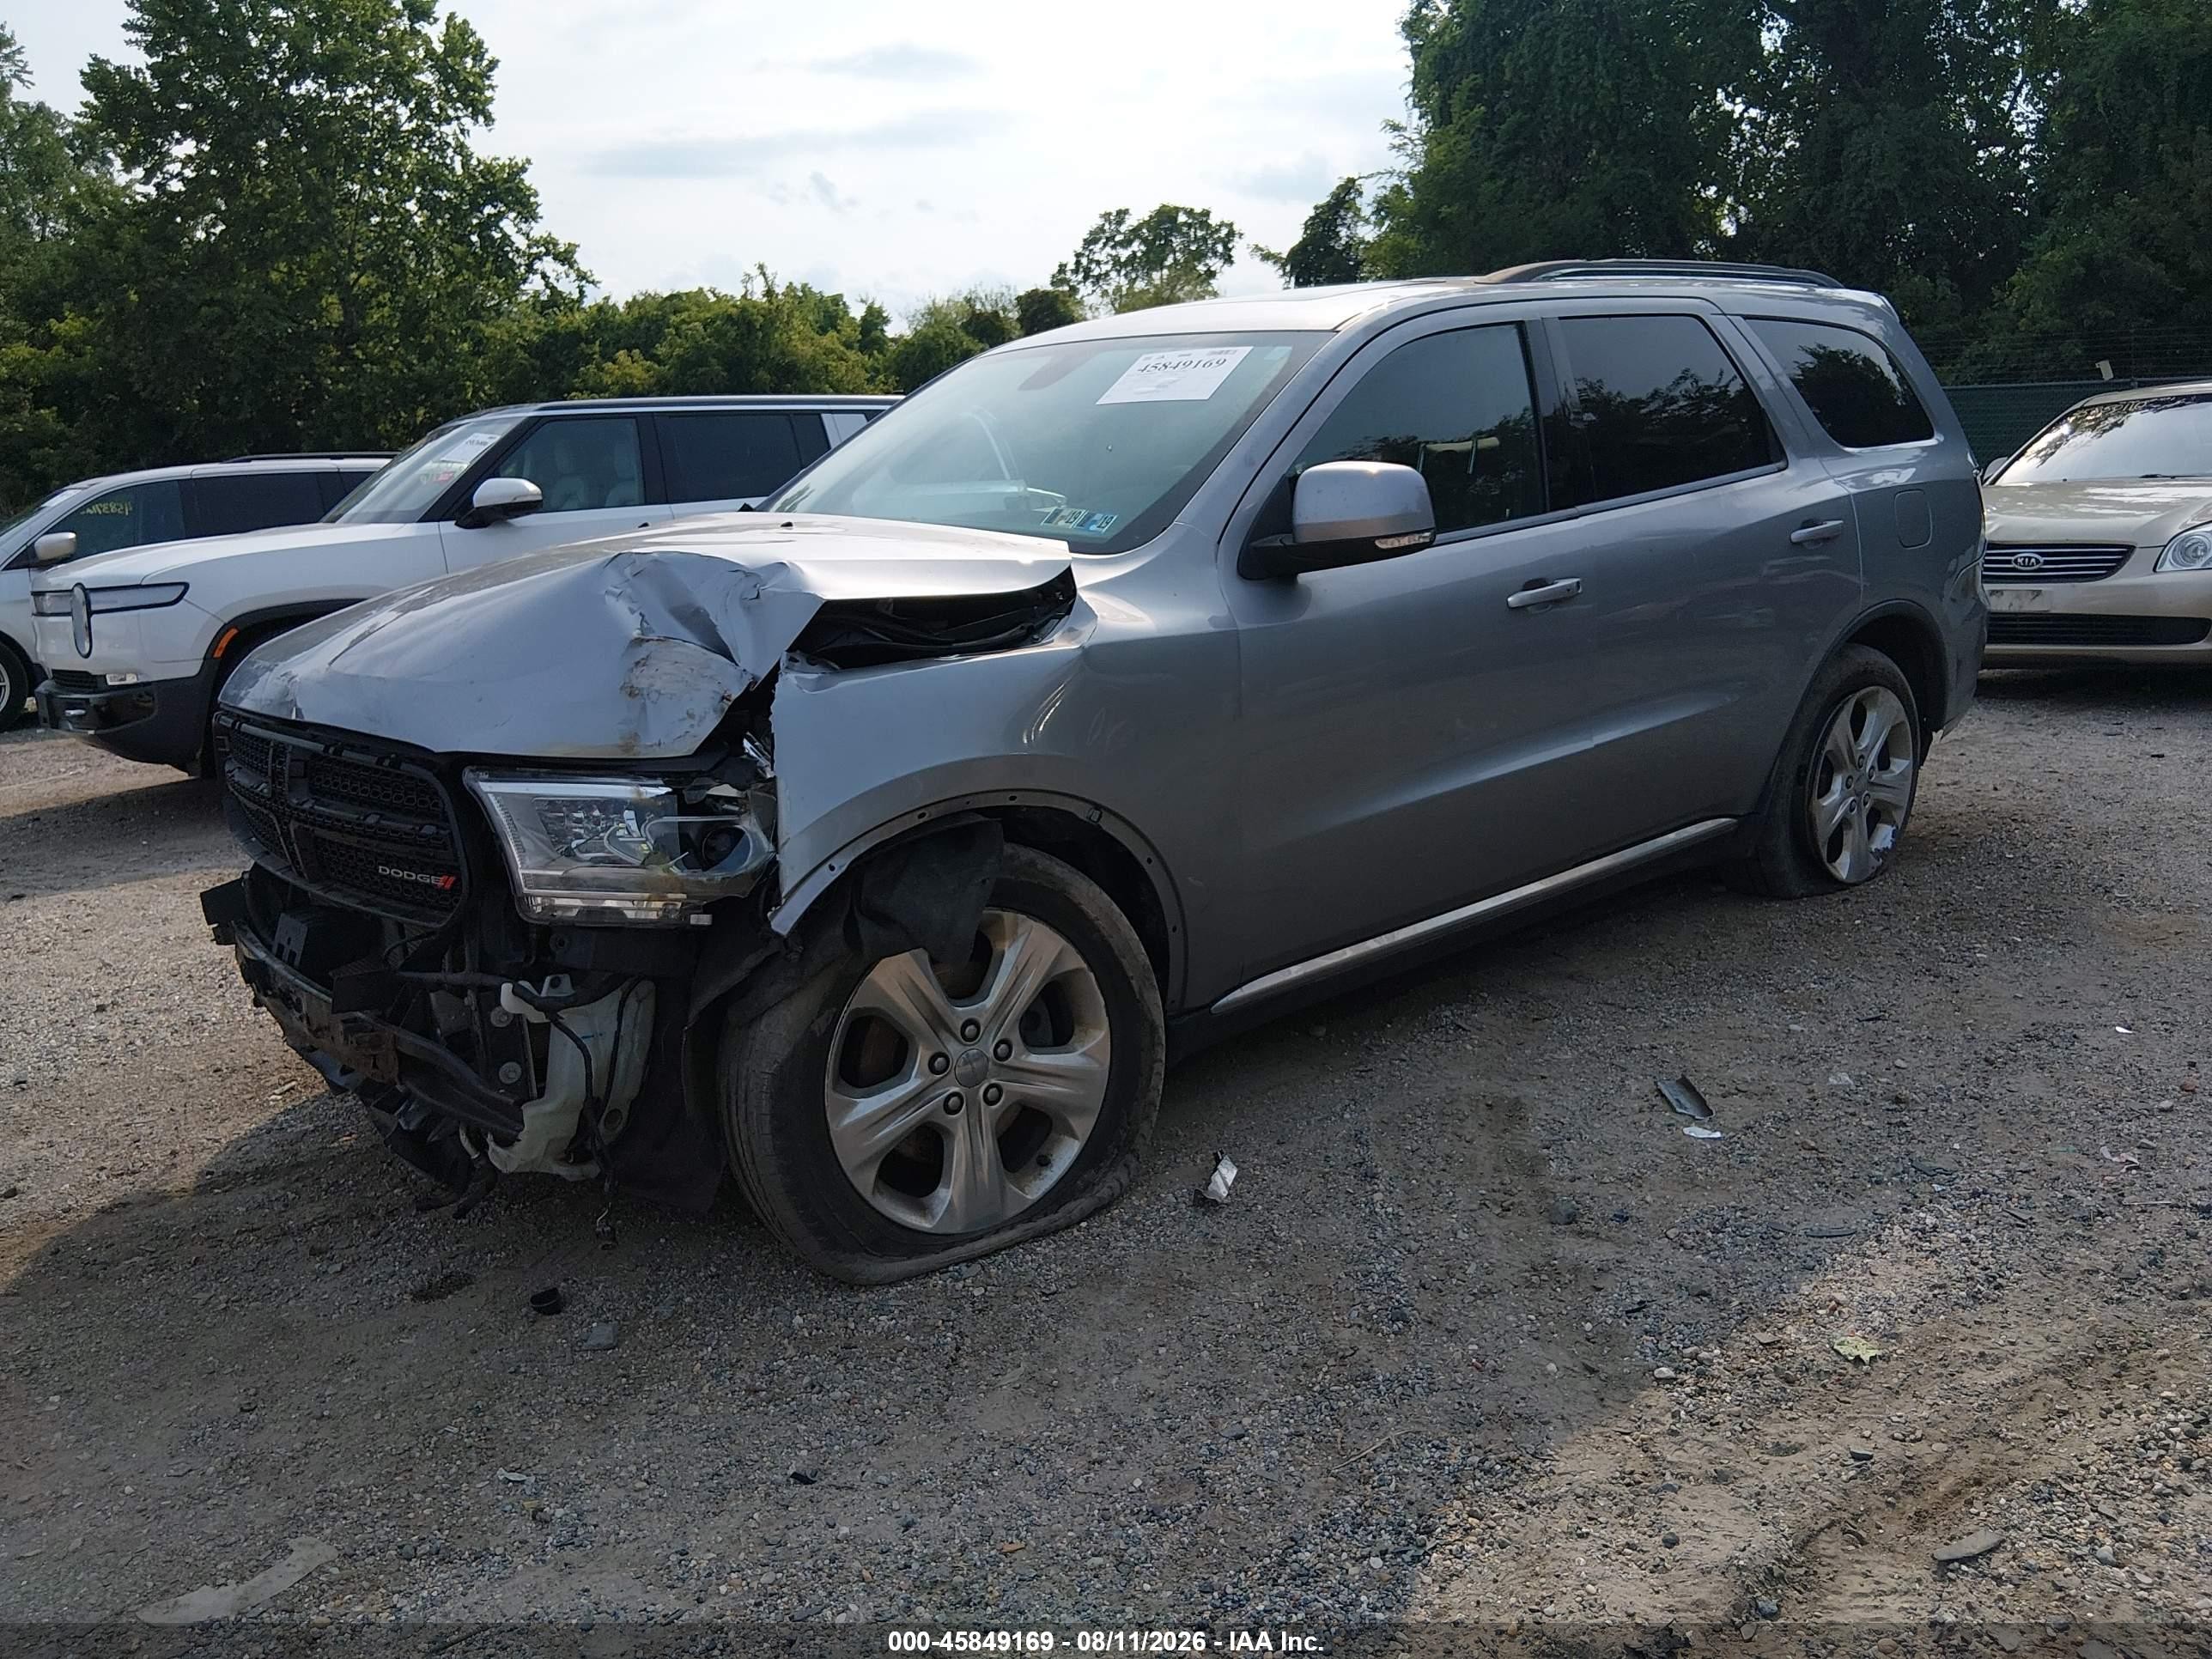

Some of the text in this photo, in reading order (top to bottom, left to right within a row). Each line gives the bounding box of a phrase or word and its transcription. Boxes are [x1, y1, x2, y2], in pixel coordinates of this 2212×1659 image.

[1138, 358, 1227, 374] 45849169
[2017, 556, 2038, 567] KIA
[378, 865, 444, 885] DODGE
